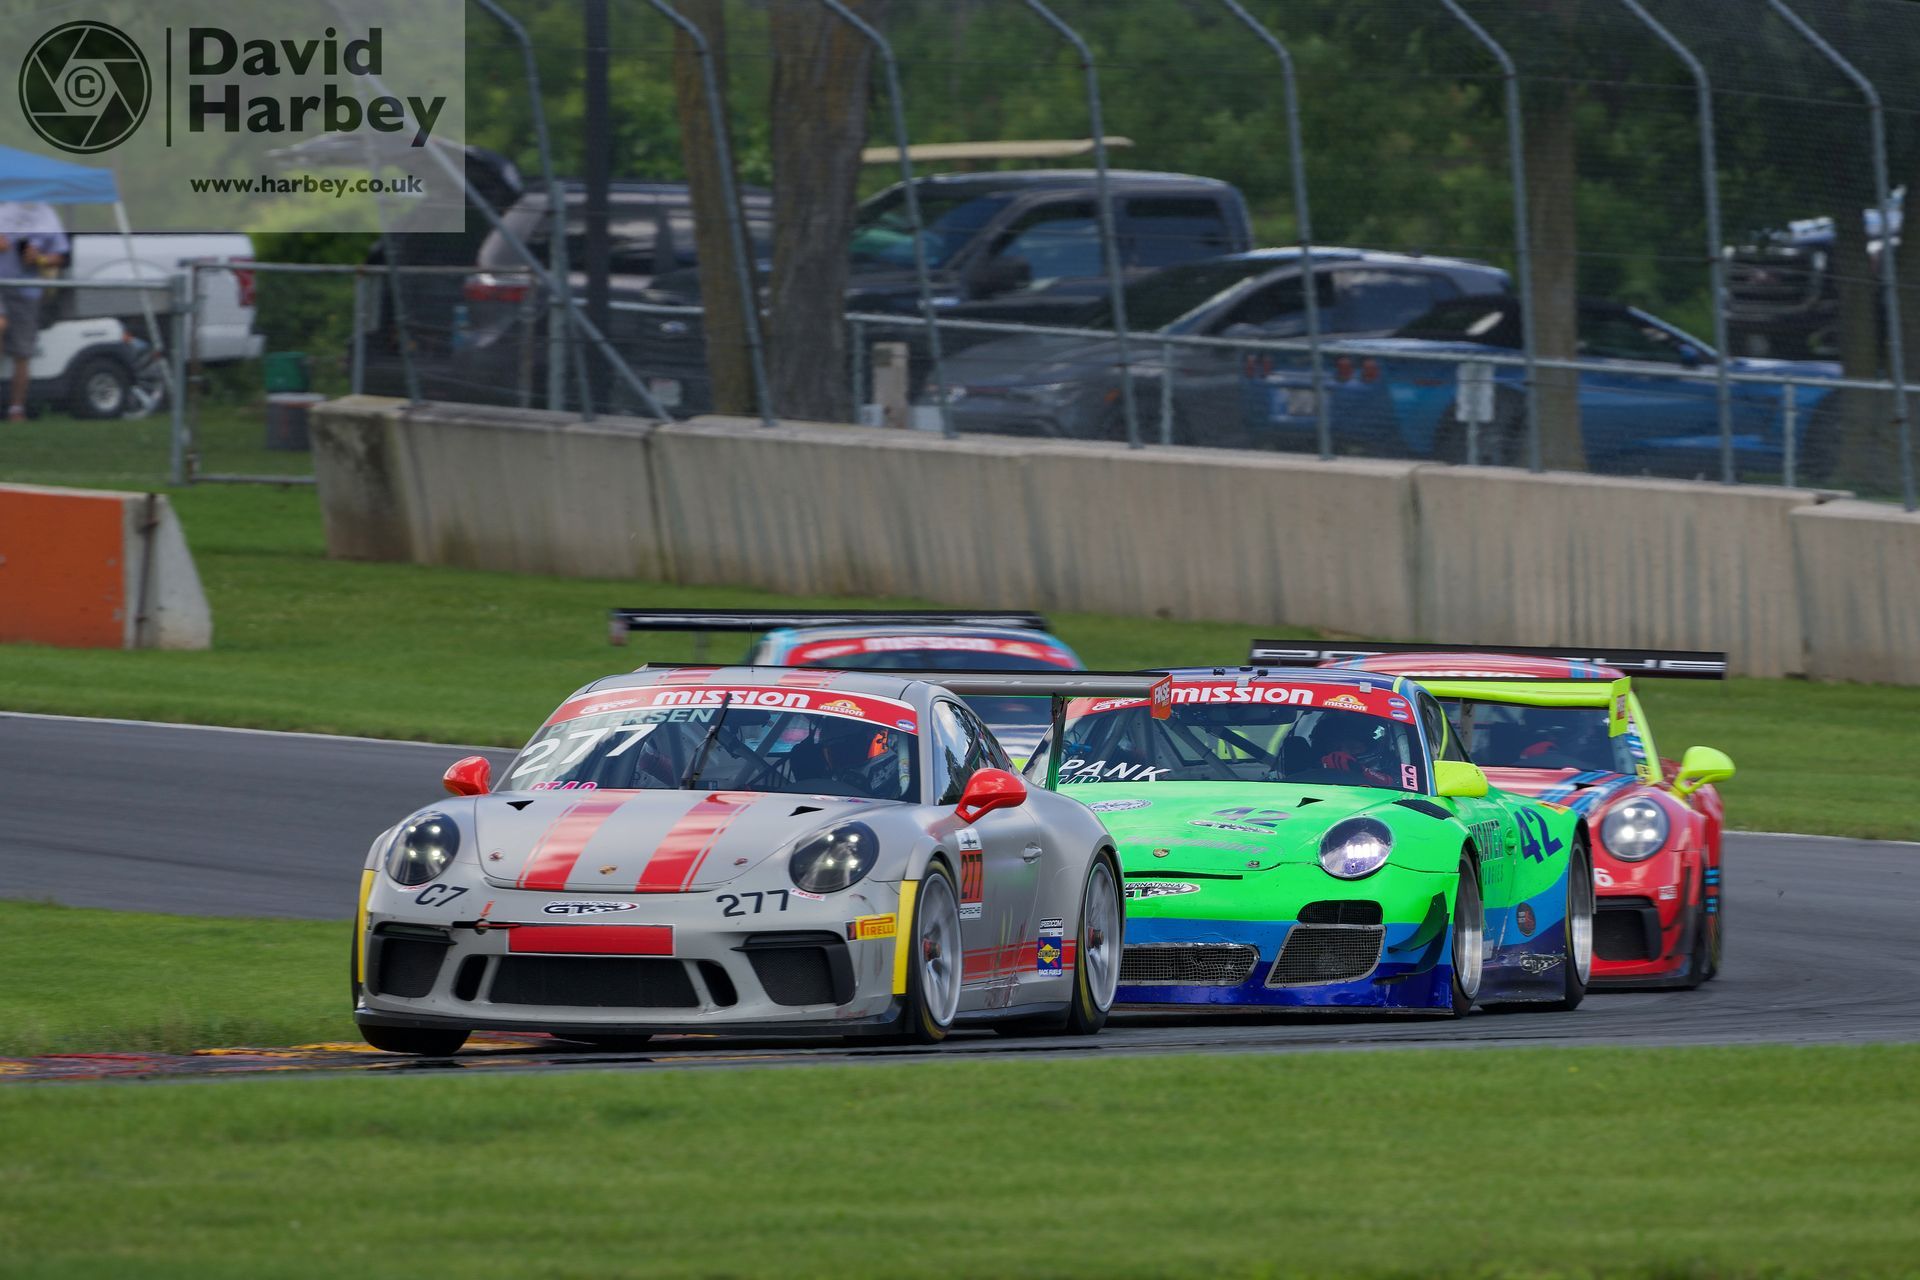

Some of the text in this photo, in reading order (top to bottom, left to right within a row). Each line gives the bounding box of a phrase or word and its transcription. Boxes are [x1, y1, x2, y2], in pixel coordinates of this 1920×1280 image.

[545, 708, 716, 740] PETERSEN
[511, 724, 658, 780] 277
[1058, 759, 1172, 782] PANK
[1212, 806, 1292, 828] 42
[1514, 806, 1564, 864] 42
[961, 853, 984, 899] 277
[415, 883, 469, 907] C7
[716, 889, 790, 918] 277
[861, 916, 895, 937] PIRELLI
